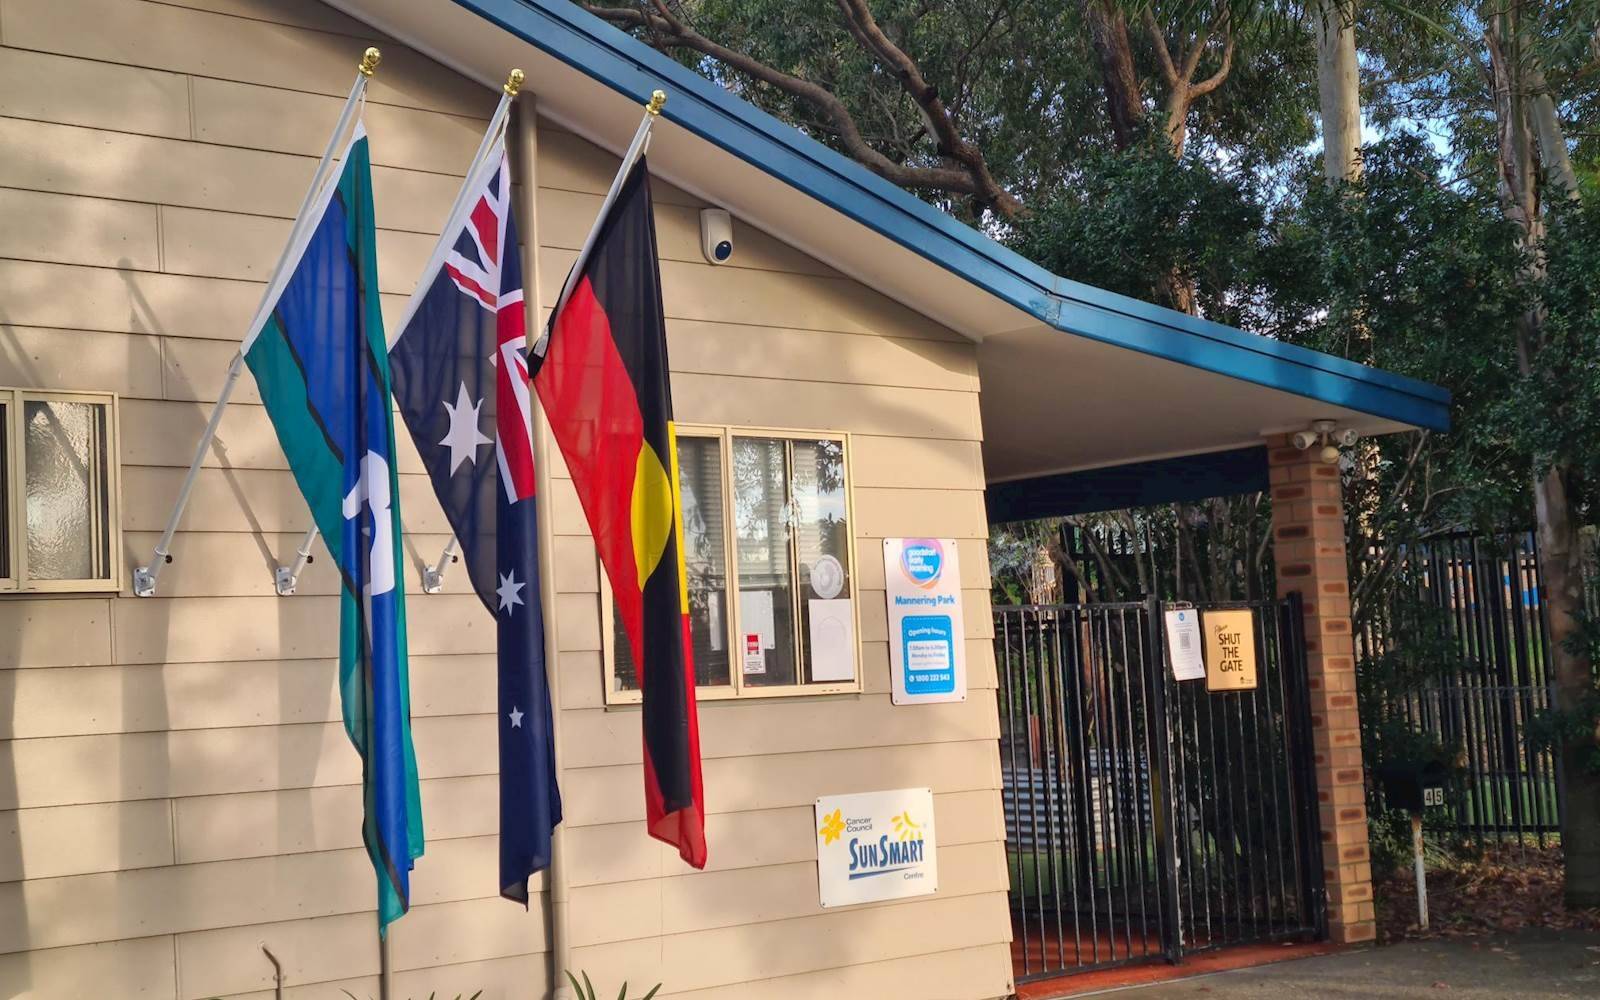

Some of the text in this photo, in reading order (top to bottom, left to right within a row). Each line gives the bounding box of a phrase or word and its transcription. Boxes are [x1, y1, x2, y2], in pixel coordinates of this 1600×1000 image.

[895, 594, 955, 606] Mannering Park
[908, 626, 931, 636] Opening
[1218, 633, 1240, 645] SHUT
[1222, 647, 1239, 658] THE
[1220, 660, 1243, 672] GATE
[916, 672, 951, 682] 1800 222 543
[1426, 790, 1441, 803] 45
[846, 818, 871, 826] Cancer
[846, 824, 873, 833] Council
[903, 872, 924, 880] Centre
